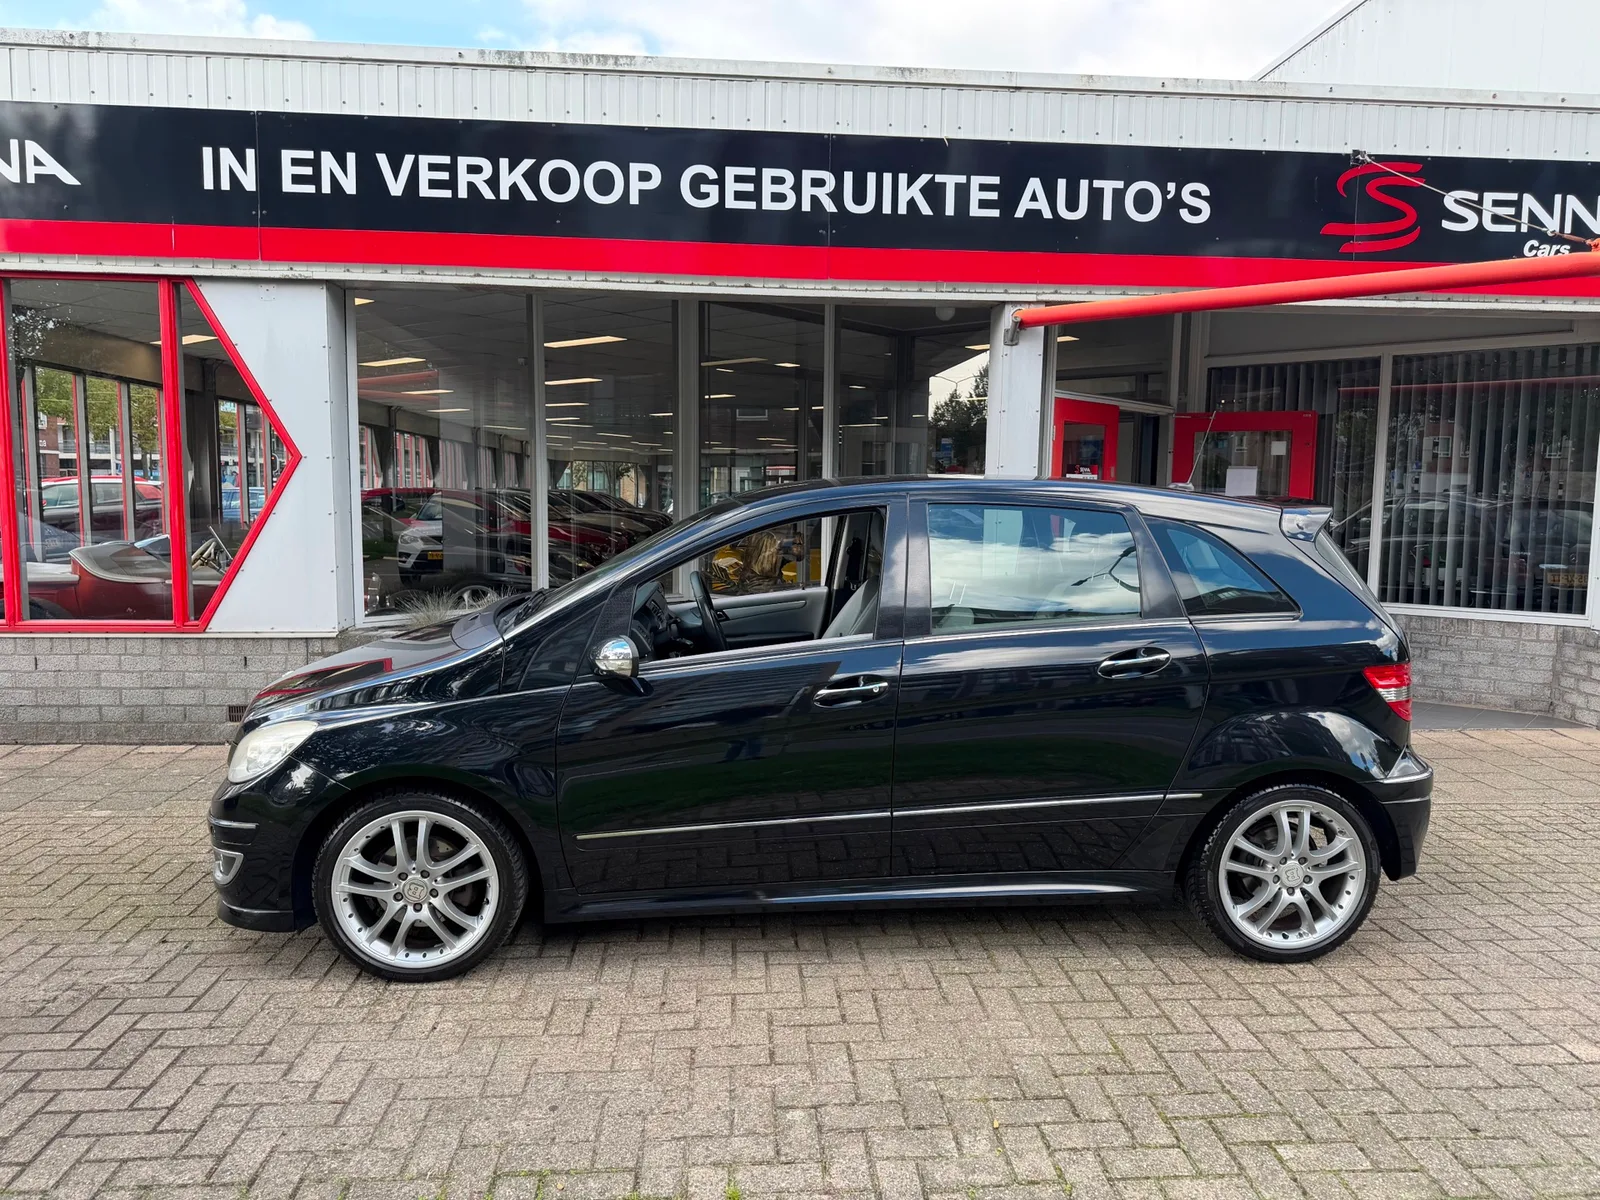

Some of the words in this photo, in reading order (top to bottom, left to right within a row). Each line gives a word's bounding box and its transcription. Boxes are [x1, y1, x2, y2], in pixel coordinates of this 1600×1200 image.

[202, 146, 257, 192] IN
[280, 149, 357, 195] EN
[375, 152, 662, 205] VERKOOP
[679, 164, 1001, 218] GEBRUIKTE
[1013, 177, 1212, 224] AUTO’S
[1441, 190, 1600, 235] SENN
[1523, 239, 1571, 258] Cars
